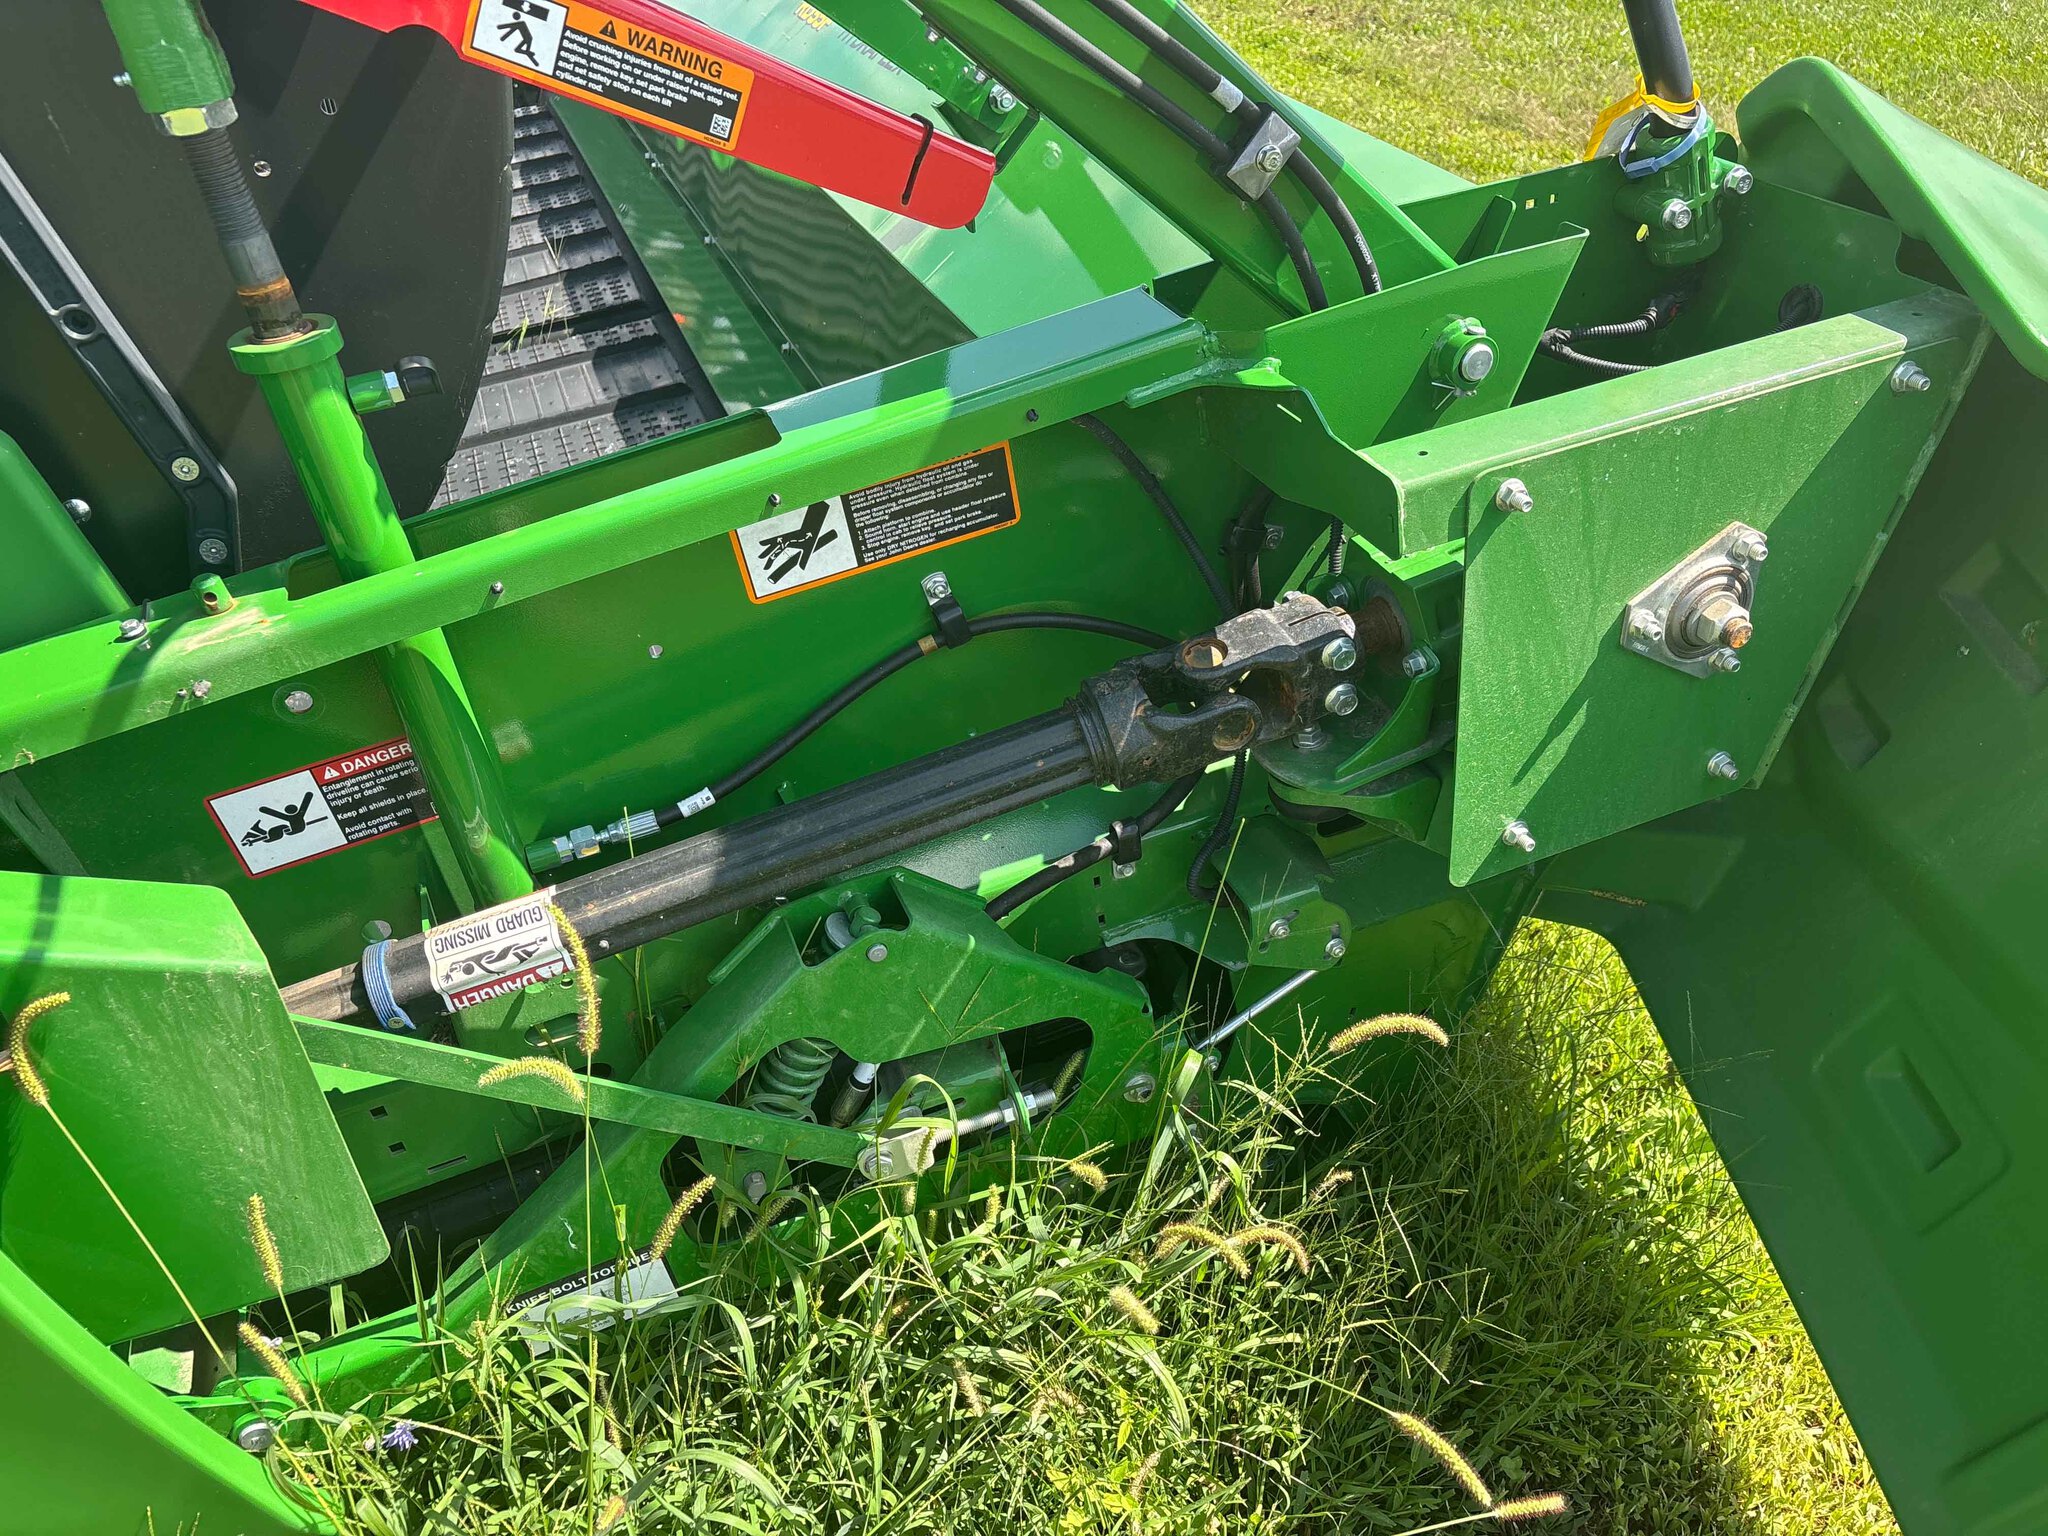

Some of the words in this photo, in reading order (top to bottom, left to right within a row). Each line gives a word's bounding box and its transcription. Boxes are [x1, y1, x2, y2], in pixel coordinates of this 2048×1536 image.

[564, 29, 587, 44] Avoid
[587, 38, 623, 59] crushing
[623, 52, 652, 70] injuries
[652, 63, 670, 75] from
[671, 70, 683, 80] fall
[683, 75, 693, 84] of
[699, 81, 722, 95] raised
[723, 90, 739, 101] reel.
[627, 28, 723, 79] WARNING
[554, 68, 587, 88] cylinder
[588, 80, 604, 92] rod.
[557, 58, 573, 70] and
[574, 65, 587, 75] set
[587, 70, 611, 86] safety
[611, 79, 630, 93] stop
[630, 87, 641, 95] on
[641, 90, 661, 103] each
[661, 97, 672, 107] lift
[559, 48, 589, 67] engine,
[589, 61, 619, 77] remove
[618, 71, 635, 85] key,
[635, 77, 648, 88] set
[647, 82, 666, 96] park
[666, 89, 688, 103] brake
[562, 39, 589, 55] Before
[589, 49, 621, 69] working
[621, 62, 632, 71] on
[632, 67, 642, 75] or
[642, 69, 665, 84] under
[665, 78, 689, 93] raised
[689, 87, 706, 101] reel,
[705, 93, 723, 107] stop
[341, 743, 412, 773] DANGER
[321, 771, 376, 793] Entanglement
[374, 767, 384, 775] in
[384, 759, 415, 773] rotating
[325, 784, 359, 799] driveline
[359, 780, 375, 788] can
[375, 772, 399, 783] cause
[399, 765, 419, 776] serio
[328, 794, 353, 807] injury
[362, 783, 387, 796] death.
[336, 808, 358, 821] Keep
[357, 805, 368, 813] all
[367, 796, 396, 810] shields
[405, 785, 429, 799] place.
[343, 821, 366, 833] Avoid
[366, 812, 395, 826] contact
[395, 806, 412, 816] with
[347, 826, 378, 841] rotating
[377, 819, 400, 831] parts.
[496, 905, 543, 934] GUARD
[435, 922, 491, 954] MISSING
[453, 973, 536, 1010] DANGER
[550, 1275, 590, 1296] BOLT
